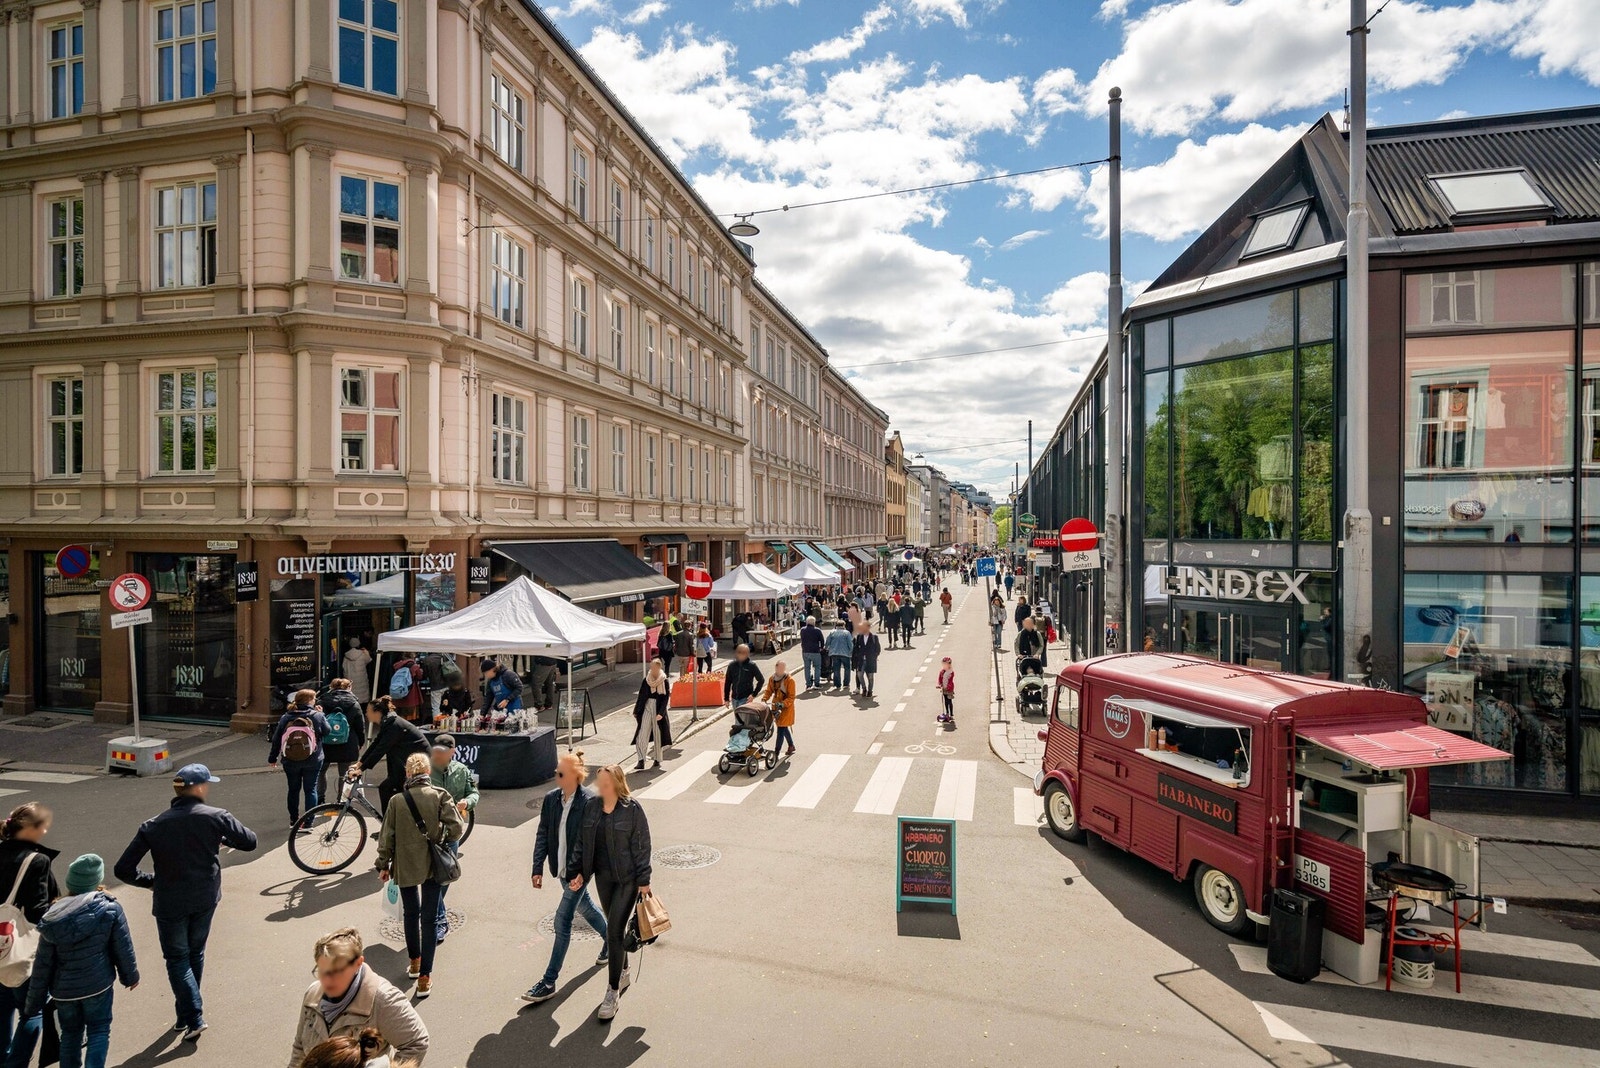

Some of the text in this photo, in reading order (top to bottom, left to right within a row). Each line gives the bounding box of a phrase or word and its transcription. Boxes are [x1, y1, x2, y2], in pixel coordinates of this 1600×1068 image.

[277, 556, 400, 574] OLIVENLUNDEN
[1159, 566, 1311, 604] LINDEX
[453, 744, 480, 763] 830
[1160, 783, 1233, 822] HABANERO
[904, 832, 944, 844] HABANERO
[906, 850, 946, 866] CHORIZO
[1303, 859, 1318, 873] PD
[1295, 868, 1326, 889] 53185
